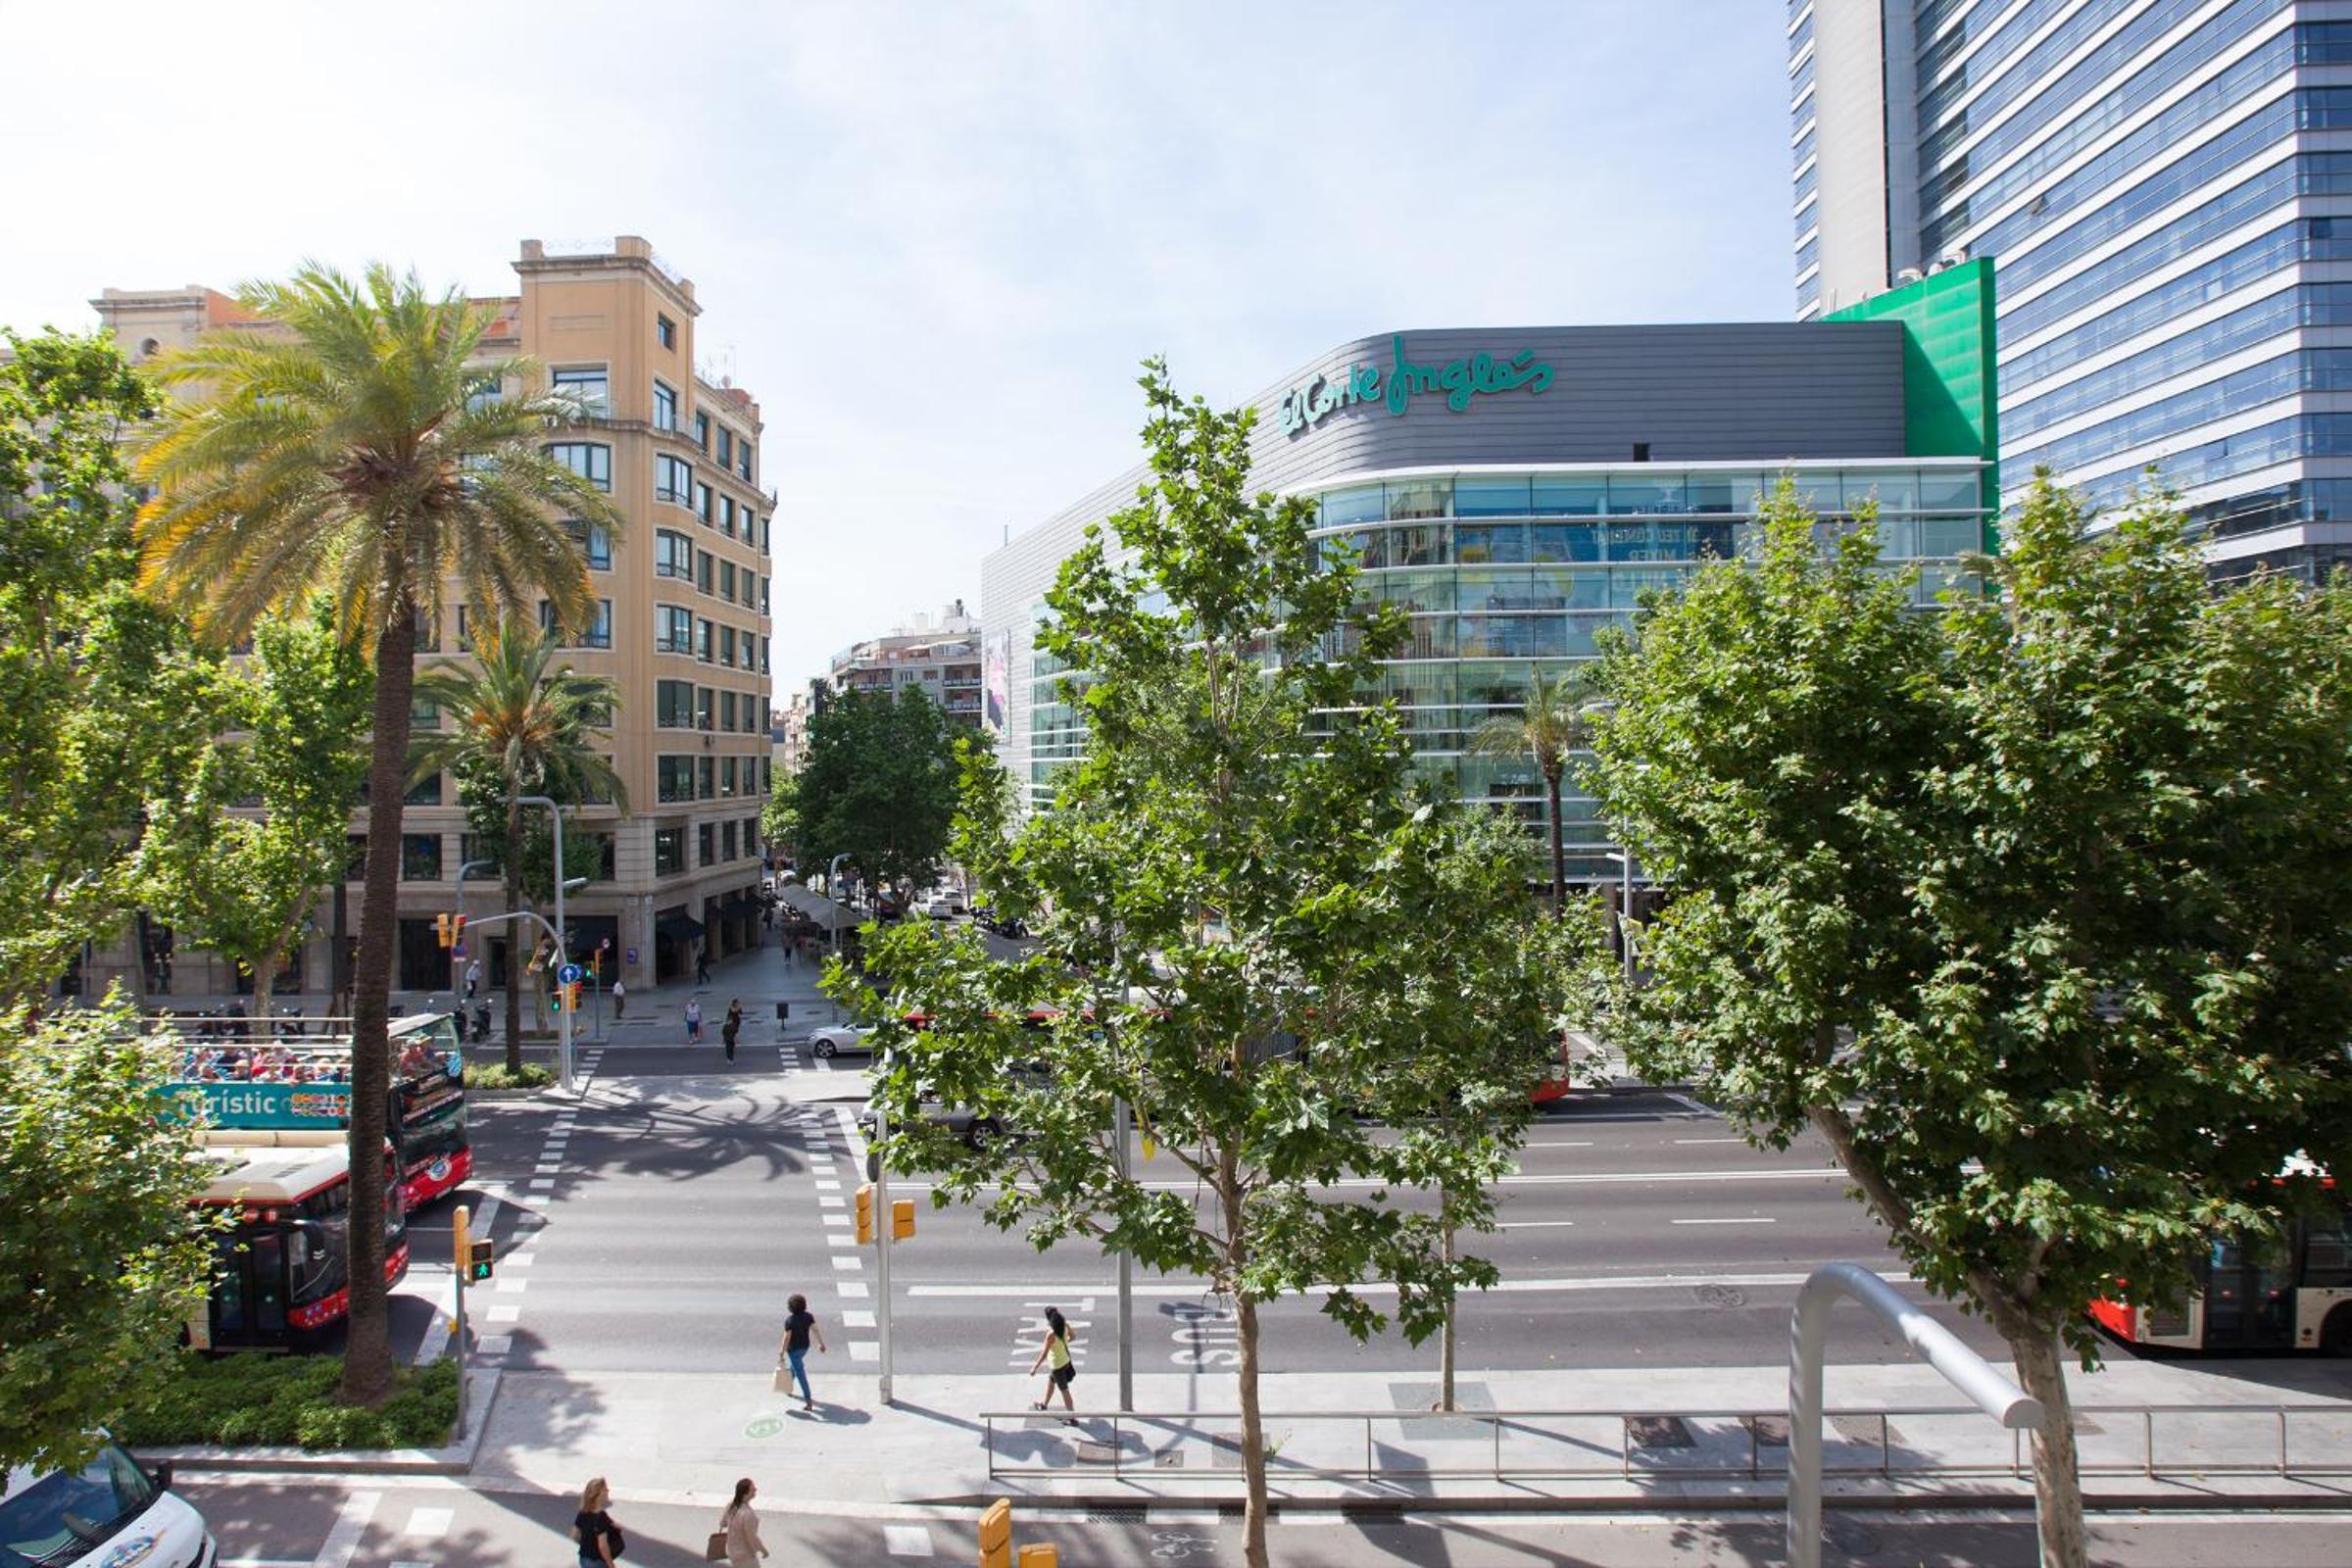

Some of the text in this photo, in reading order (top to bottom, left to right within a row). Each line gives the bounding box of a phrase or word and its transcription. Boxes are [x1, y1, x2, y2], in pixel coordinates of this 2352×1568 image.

[1276, 333, 1555, 436] El Corte Inglés
[1008, 1297, 1096, 1366] TAXI
